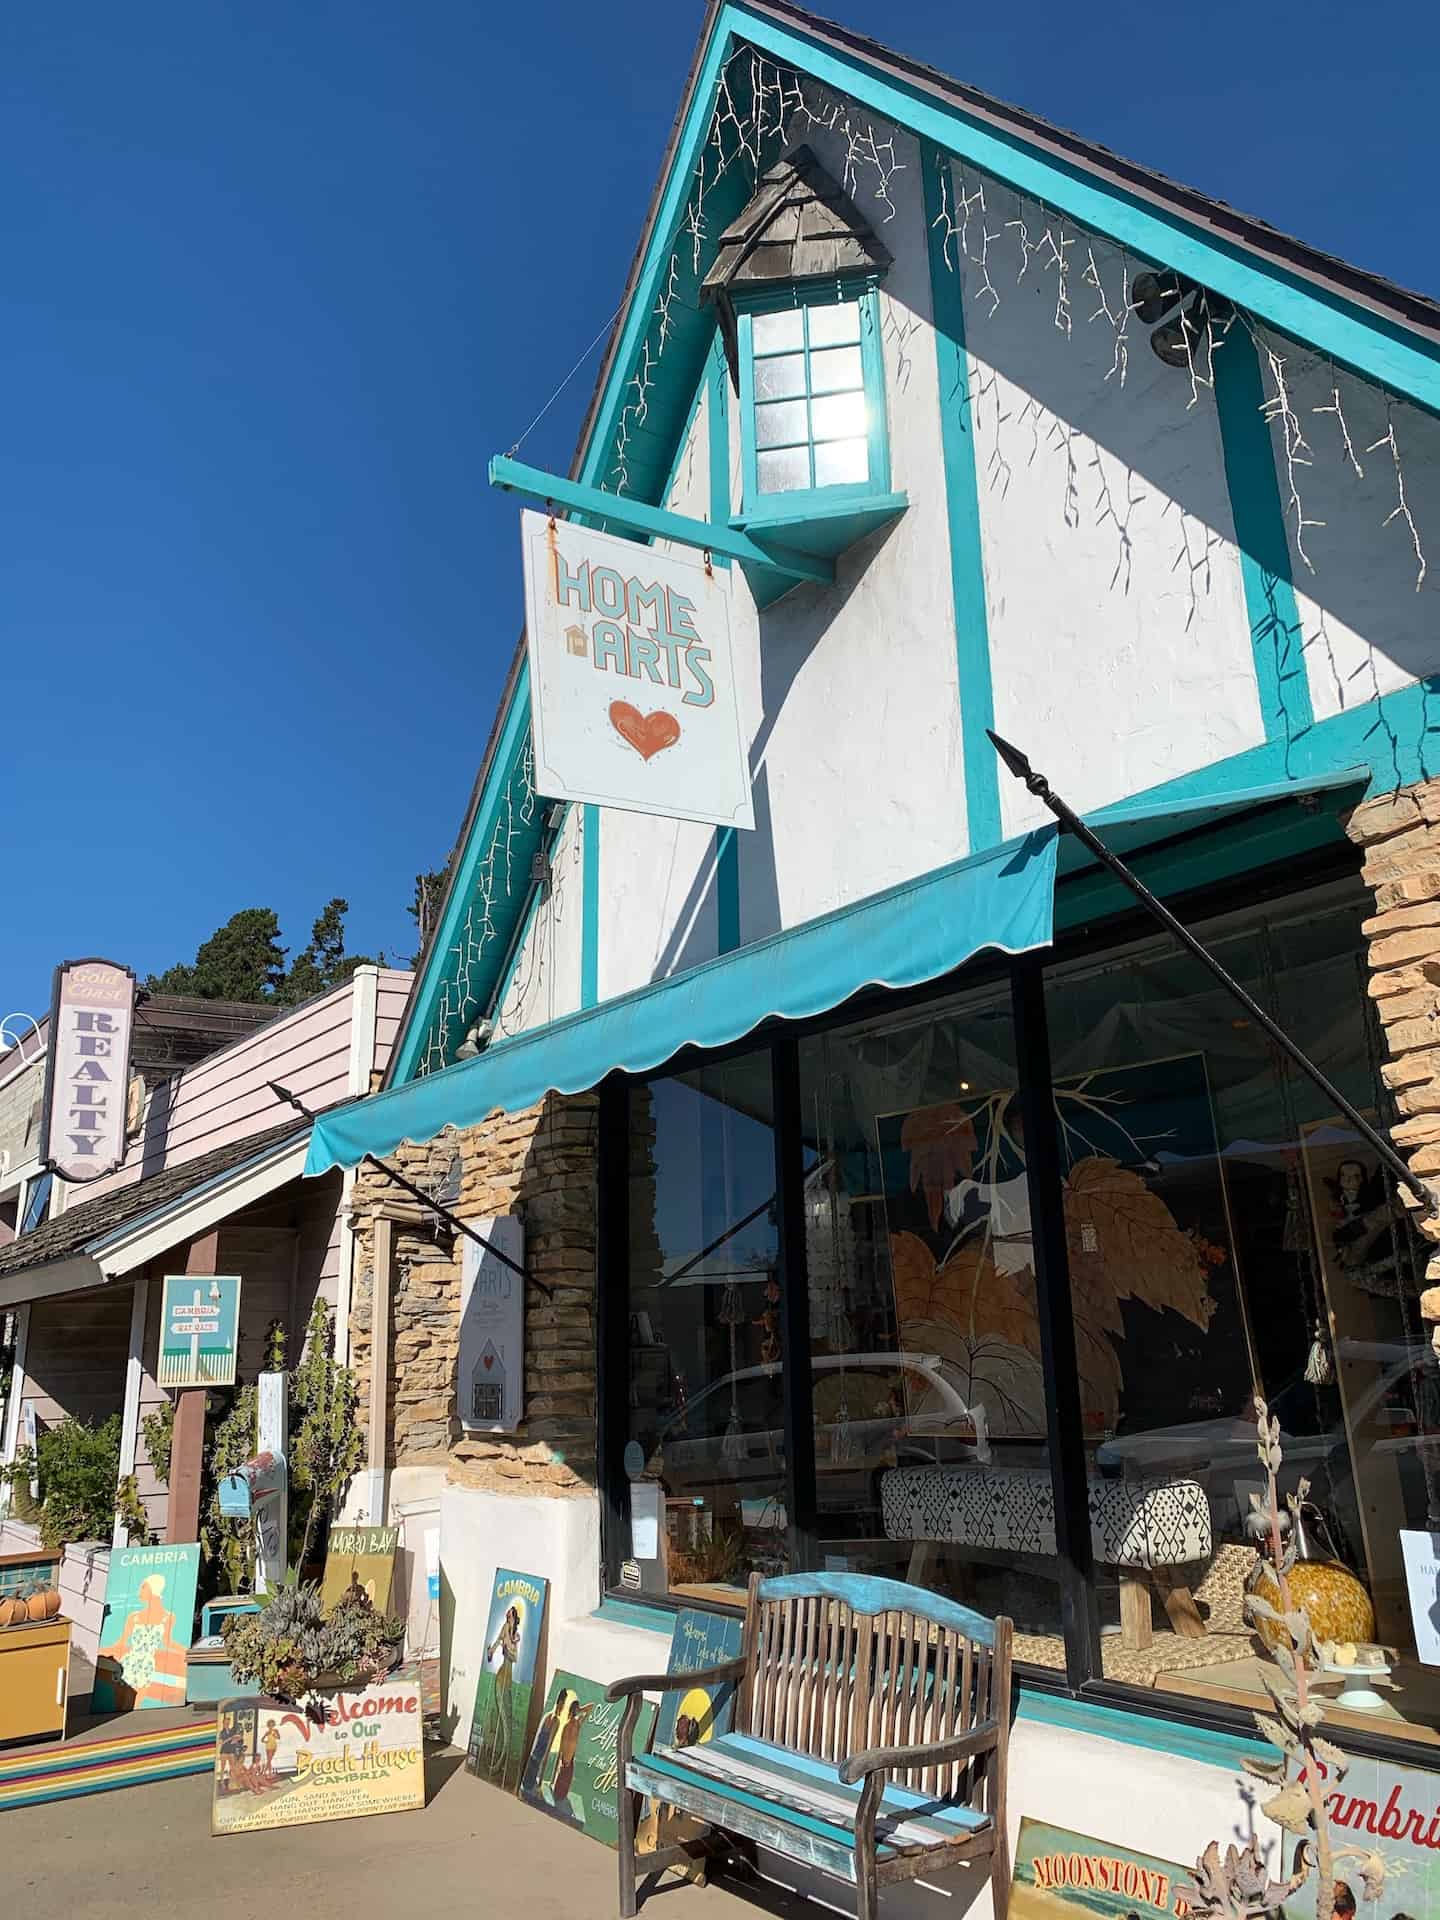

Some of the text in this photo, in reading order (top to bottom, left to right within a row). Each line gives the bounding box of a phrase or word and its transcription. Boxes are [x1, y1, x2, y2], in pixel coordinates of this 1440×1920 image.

[554, 550, 702, 643] HOME
[591, 619, 715, 708] ARTS
[65, 1011, 120, 1156] REALTY
[478, 1264, 512, 1299] ARTS
[175, 1306, 216, 1315] CAMBRIA
[120, 1551, 188, 1568] CAMBRIA
[369, 1530, 394, 1555] BAY
[497, 1580, 540, 1608] CAMBRIA
[279, 1695, 418, 1743] Welcome
[334, 1721, 381, 1741] to Our
[591, 1713, 619, 1752] Aff
[288, 1740, 417, 1785] Beach House
[312, 1769, 391, 1786] CAMBRIA
[591, 1797, 619, 1819] CAMBRI
[1033, 1855, 1169, 1908] MOONSTONE
